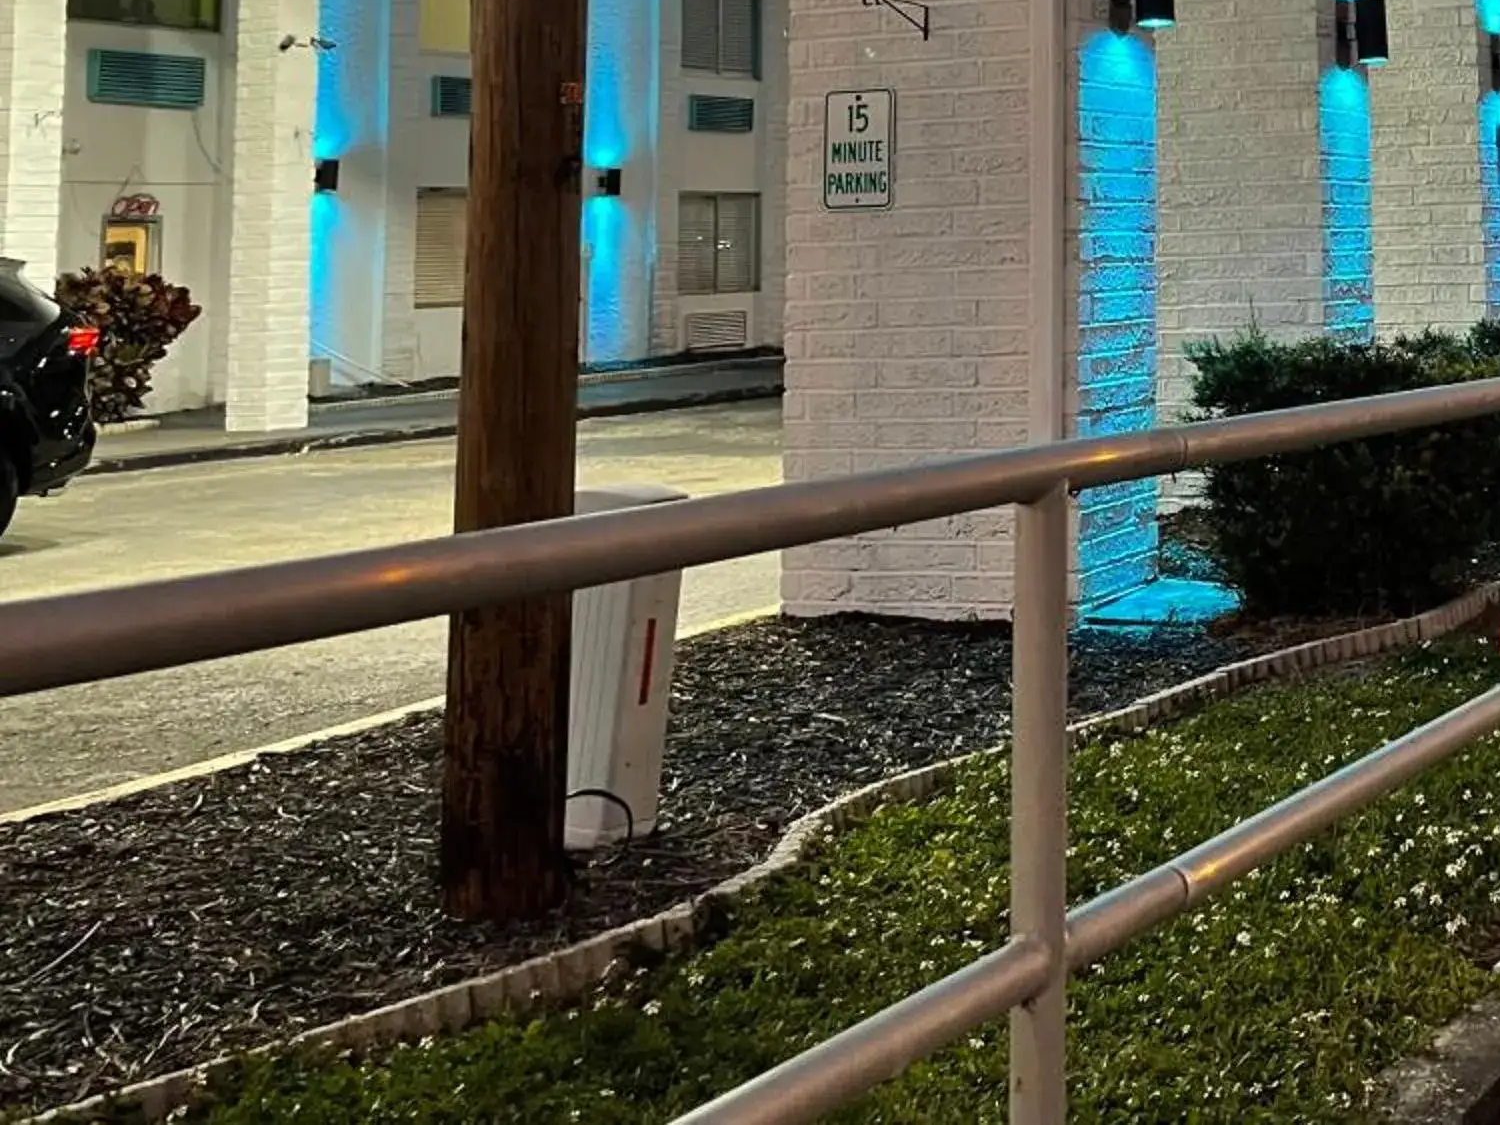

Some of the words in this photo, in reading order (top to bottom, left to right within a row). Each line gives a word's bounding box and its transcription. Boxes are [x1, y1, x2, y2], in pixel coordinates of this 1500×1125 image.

[847, 104, 869, 133] 15
[831, 140, 884, 164] MINUTE
[827, 171, 887, 195] PARKING
